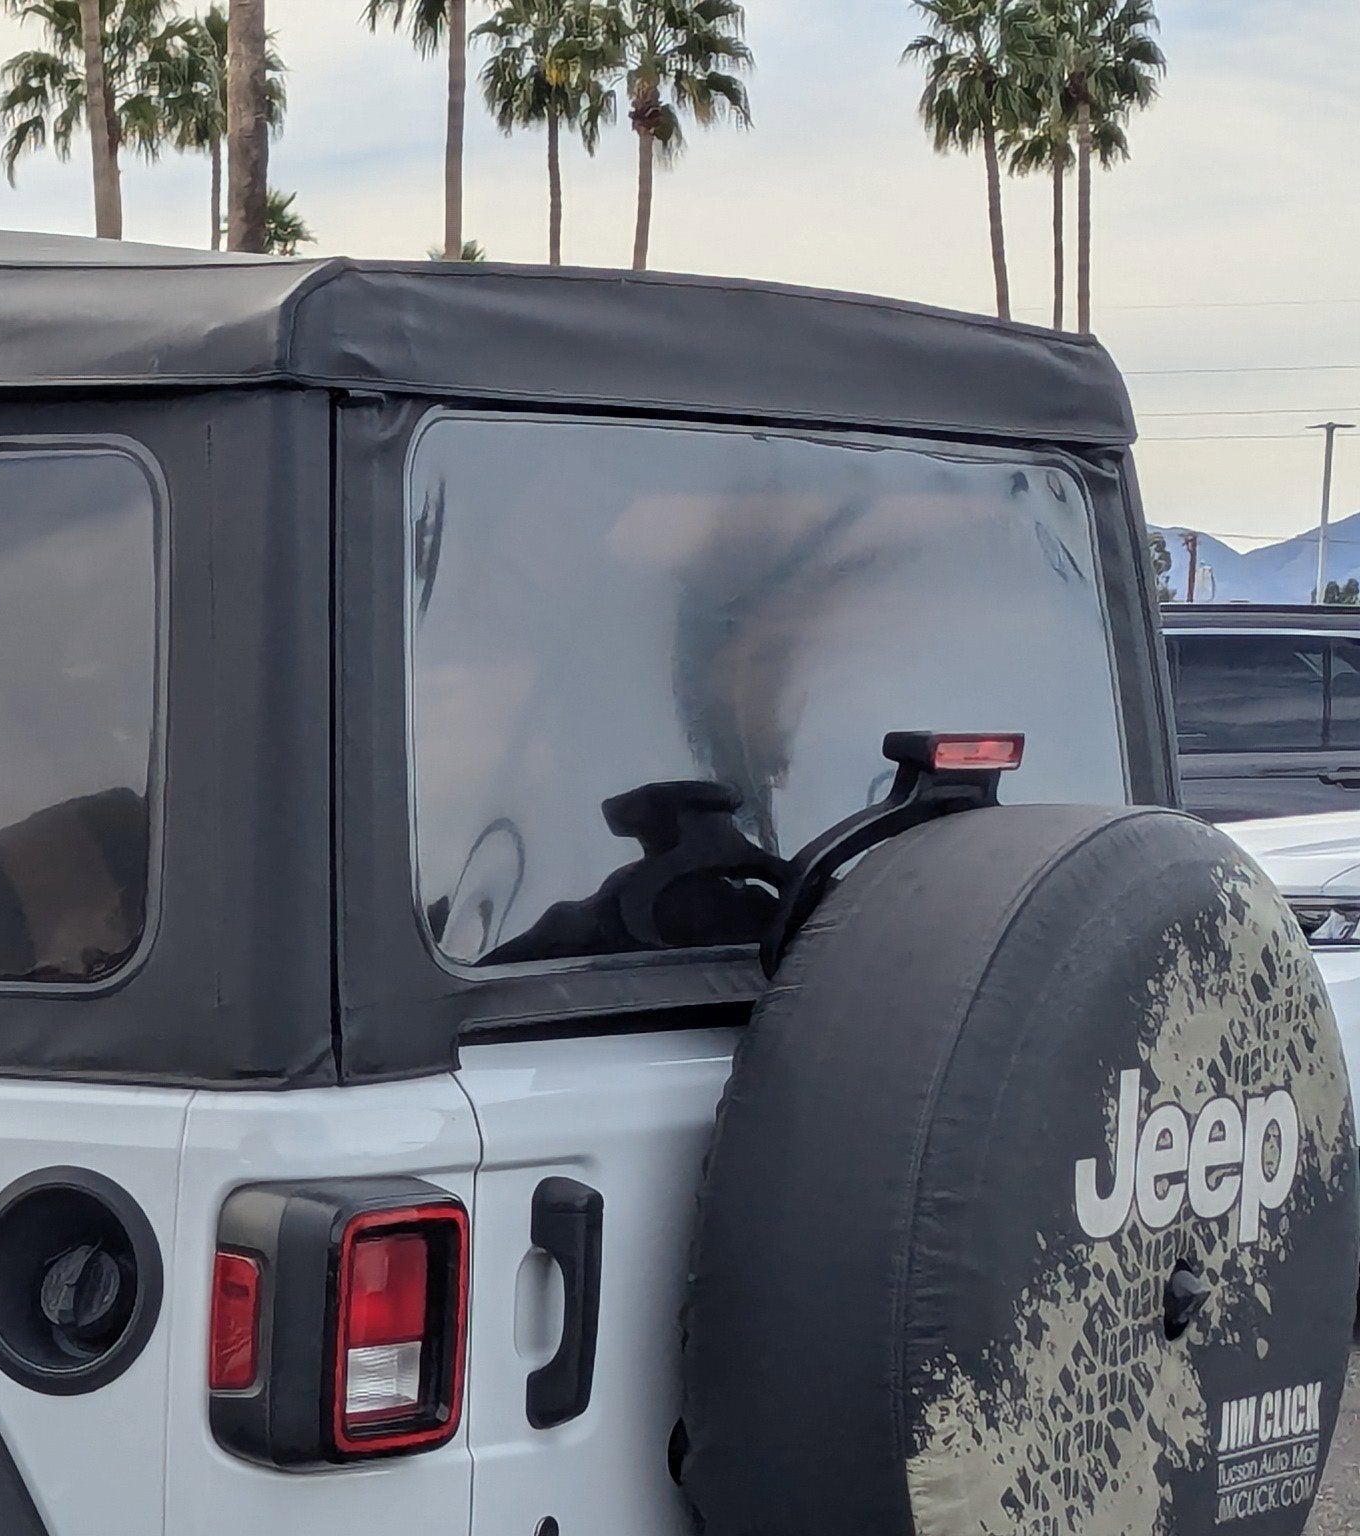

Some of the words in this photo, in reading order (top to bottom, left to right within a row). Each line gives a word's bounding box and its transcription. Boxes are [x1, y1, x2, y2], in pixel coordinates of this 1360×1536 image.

[1075, 1068, 1300, 1244] Jeep
[1216, 1396, 1257, 1451] JIM
[1258, 1380, 1322, 1442] CLICK
[1260, 1451, 1289, 1476] Auto
